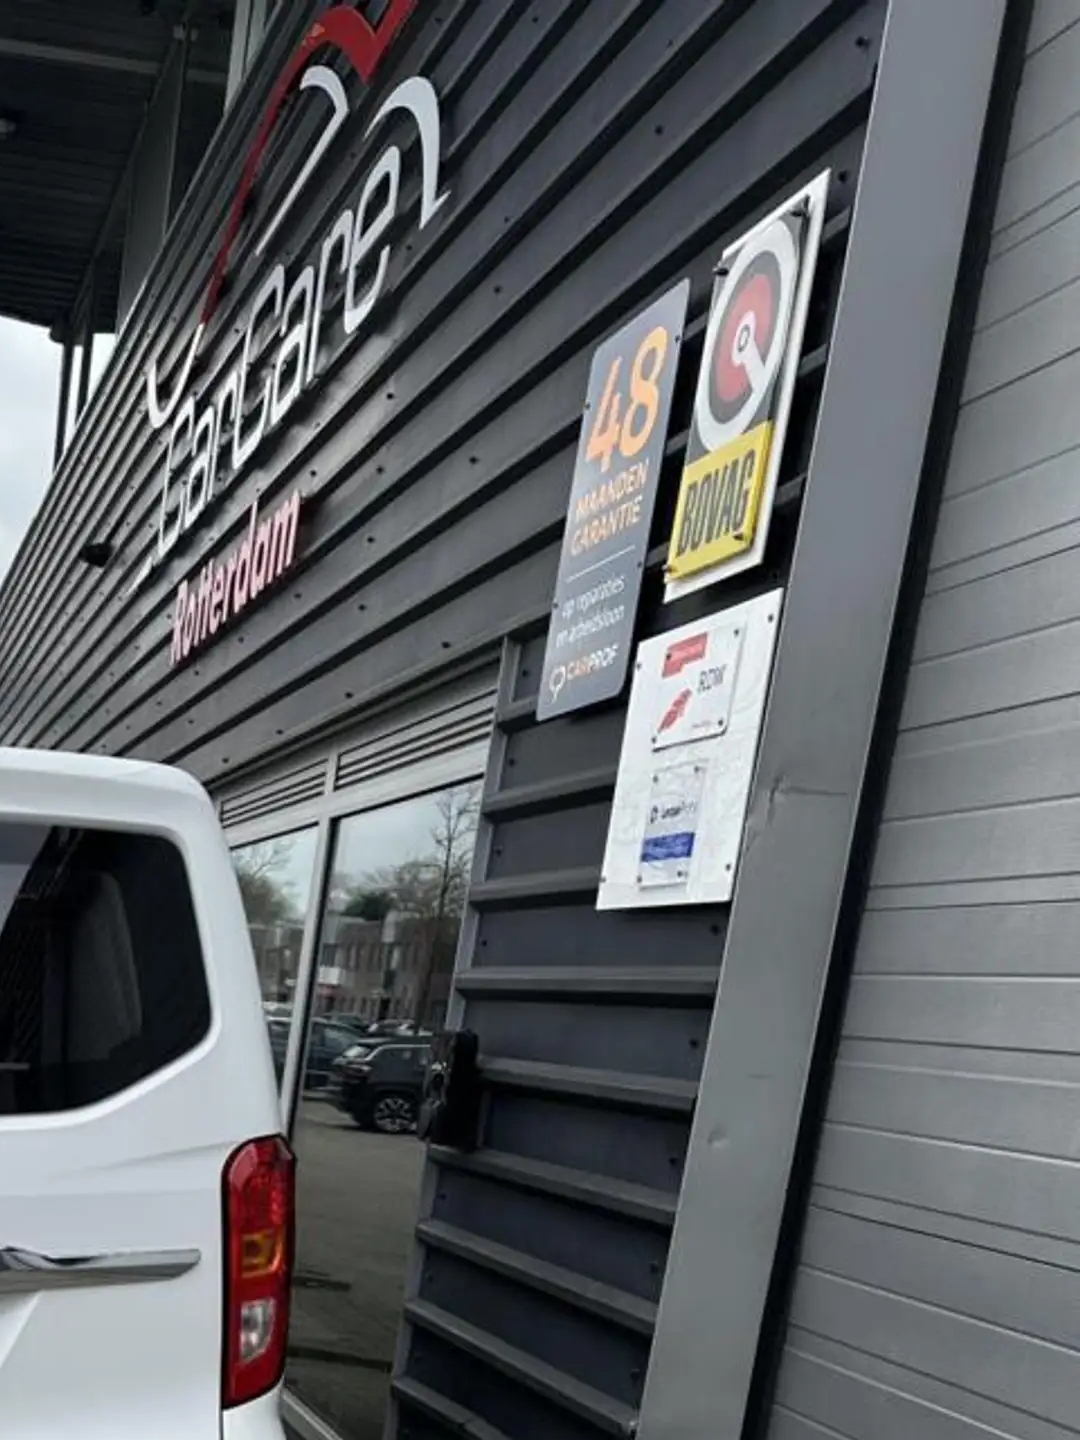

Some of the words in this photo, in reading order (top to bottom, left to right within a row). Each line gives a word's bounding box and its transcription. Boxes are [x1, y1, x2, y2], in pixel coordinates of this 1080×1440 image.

[586, 325, 668, 473] 48
[570, 494, 644, 557] GARANTIE
[575, 457, 650, 521] MAANDEN
[676, 449, 756, 558] BOVAG
[170, 490, 301, 668] Rotterdam
